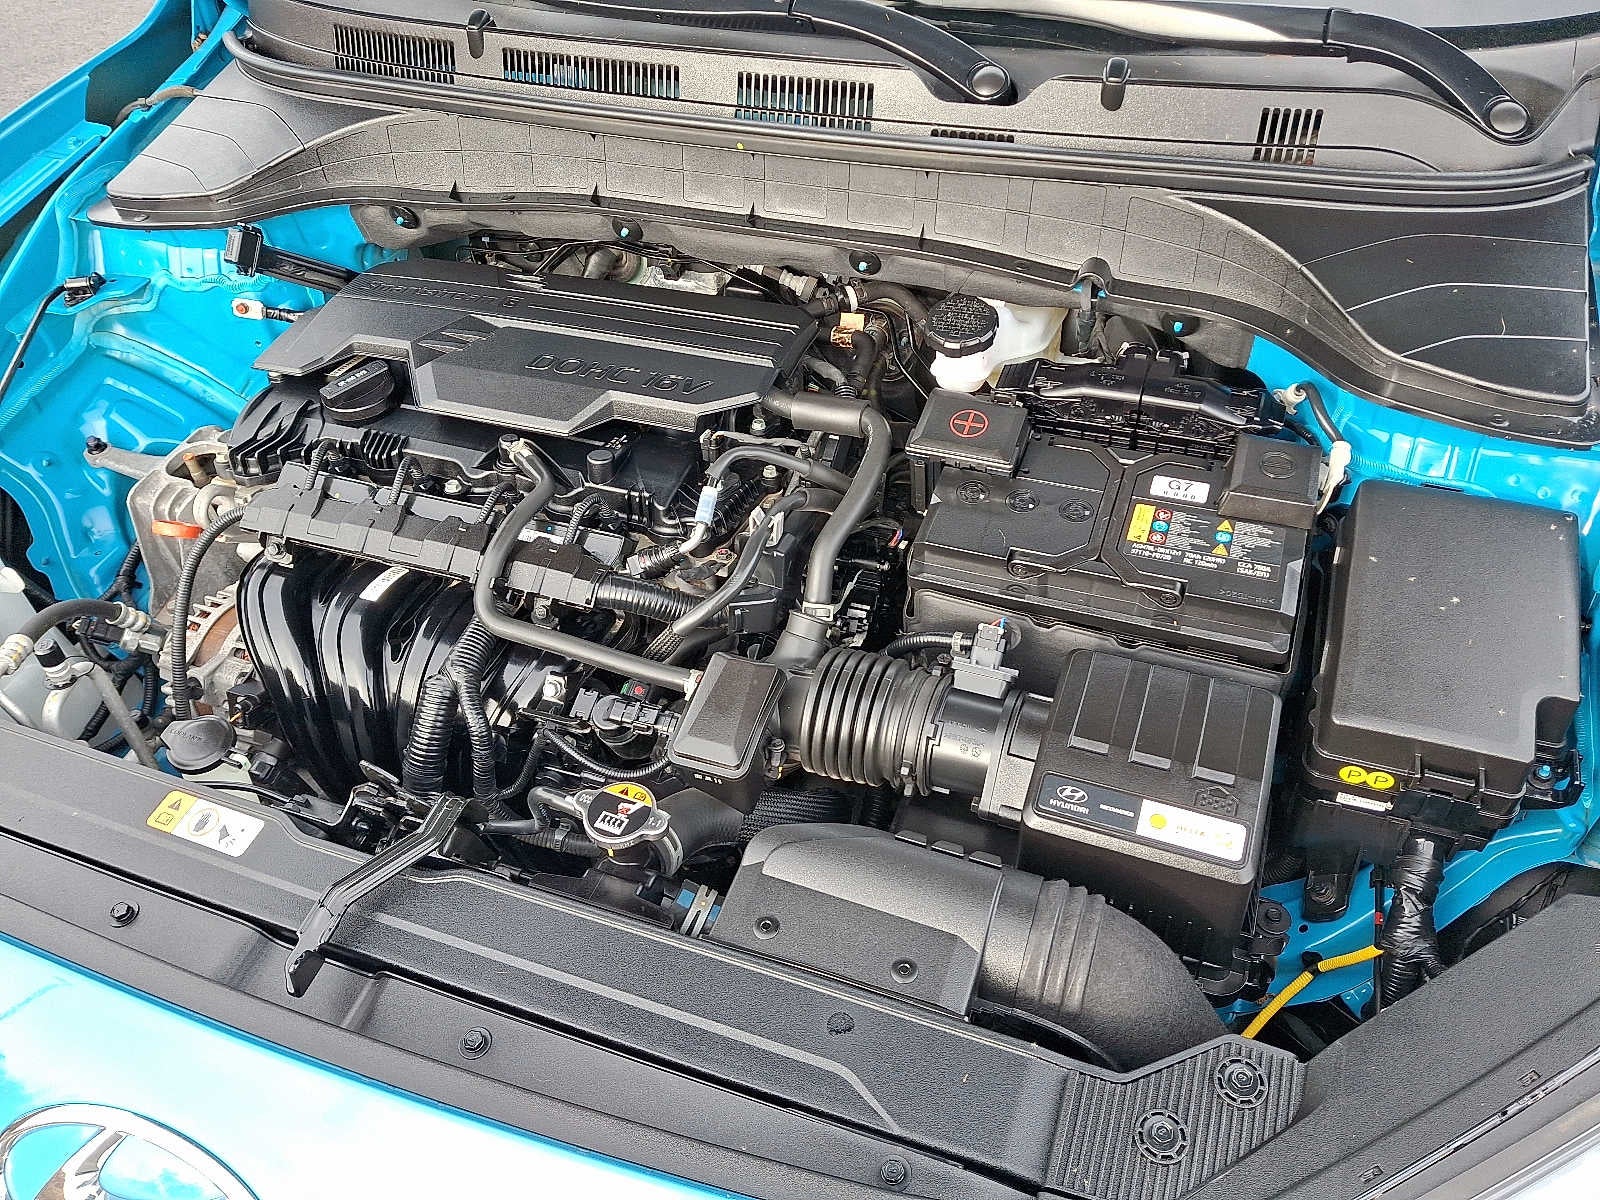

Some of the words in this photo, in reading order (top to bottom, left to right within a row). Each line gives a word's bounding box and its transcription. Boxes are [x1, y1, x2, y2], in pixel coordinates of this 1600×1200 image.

[525, 353, 640, 385] DOHC
[641, 371, 715, 395] 16V
[1168, 479, 1194, 492] G7
[1347, 769, 1362, 779] P
[1373, 775, 1389, 785] P
[1049, 798, 1090, 816] HYUNDAI
